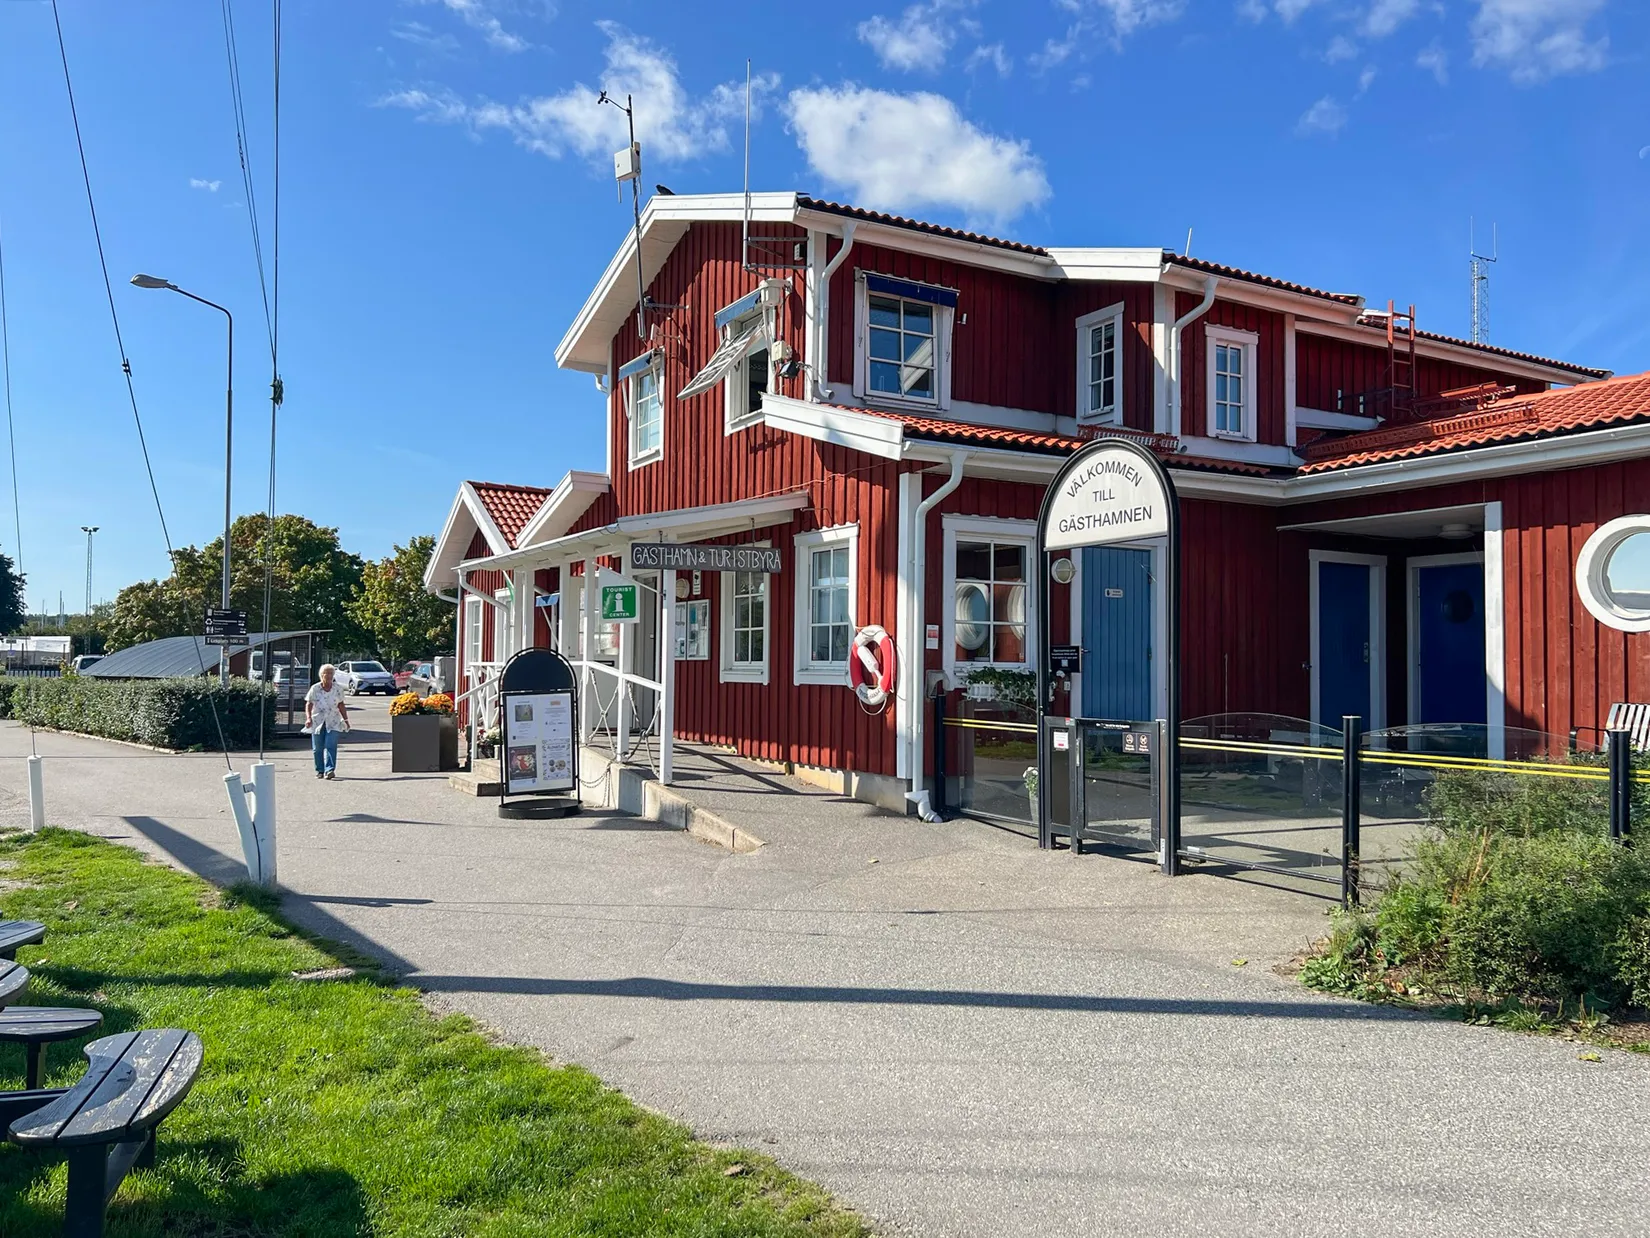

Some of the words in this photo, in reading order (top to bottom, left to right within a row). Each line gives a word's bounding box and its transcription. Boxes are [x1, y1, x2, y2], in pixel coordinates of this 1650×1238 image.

[1067, 461, 1143, 498] VÄLKOMMEN
[1092, 488, 1116, 502] TILL
[1058, 505, 1152, 533] GÄSTHAMNEN
[632, 547, 698, 566] GÄSTHAMN
[699, 551, 707, 564] &
[708, 548, 782, 570] TURISTBYRÅ
